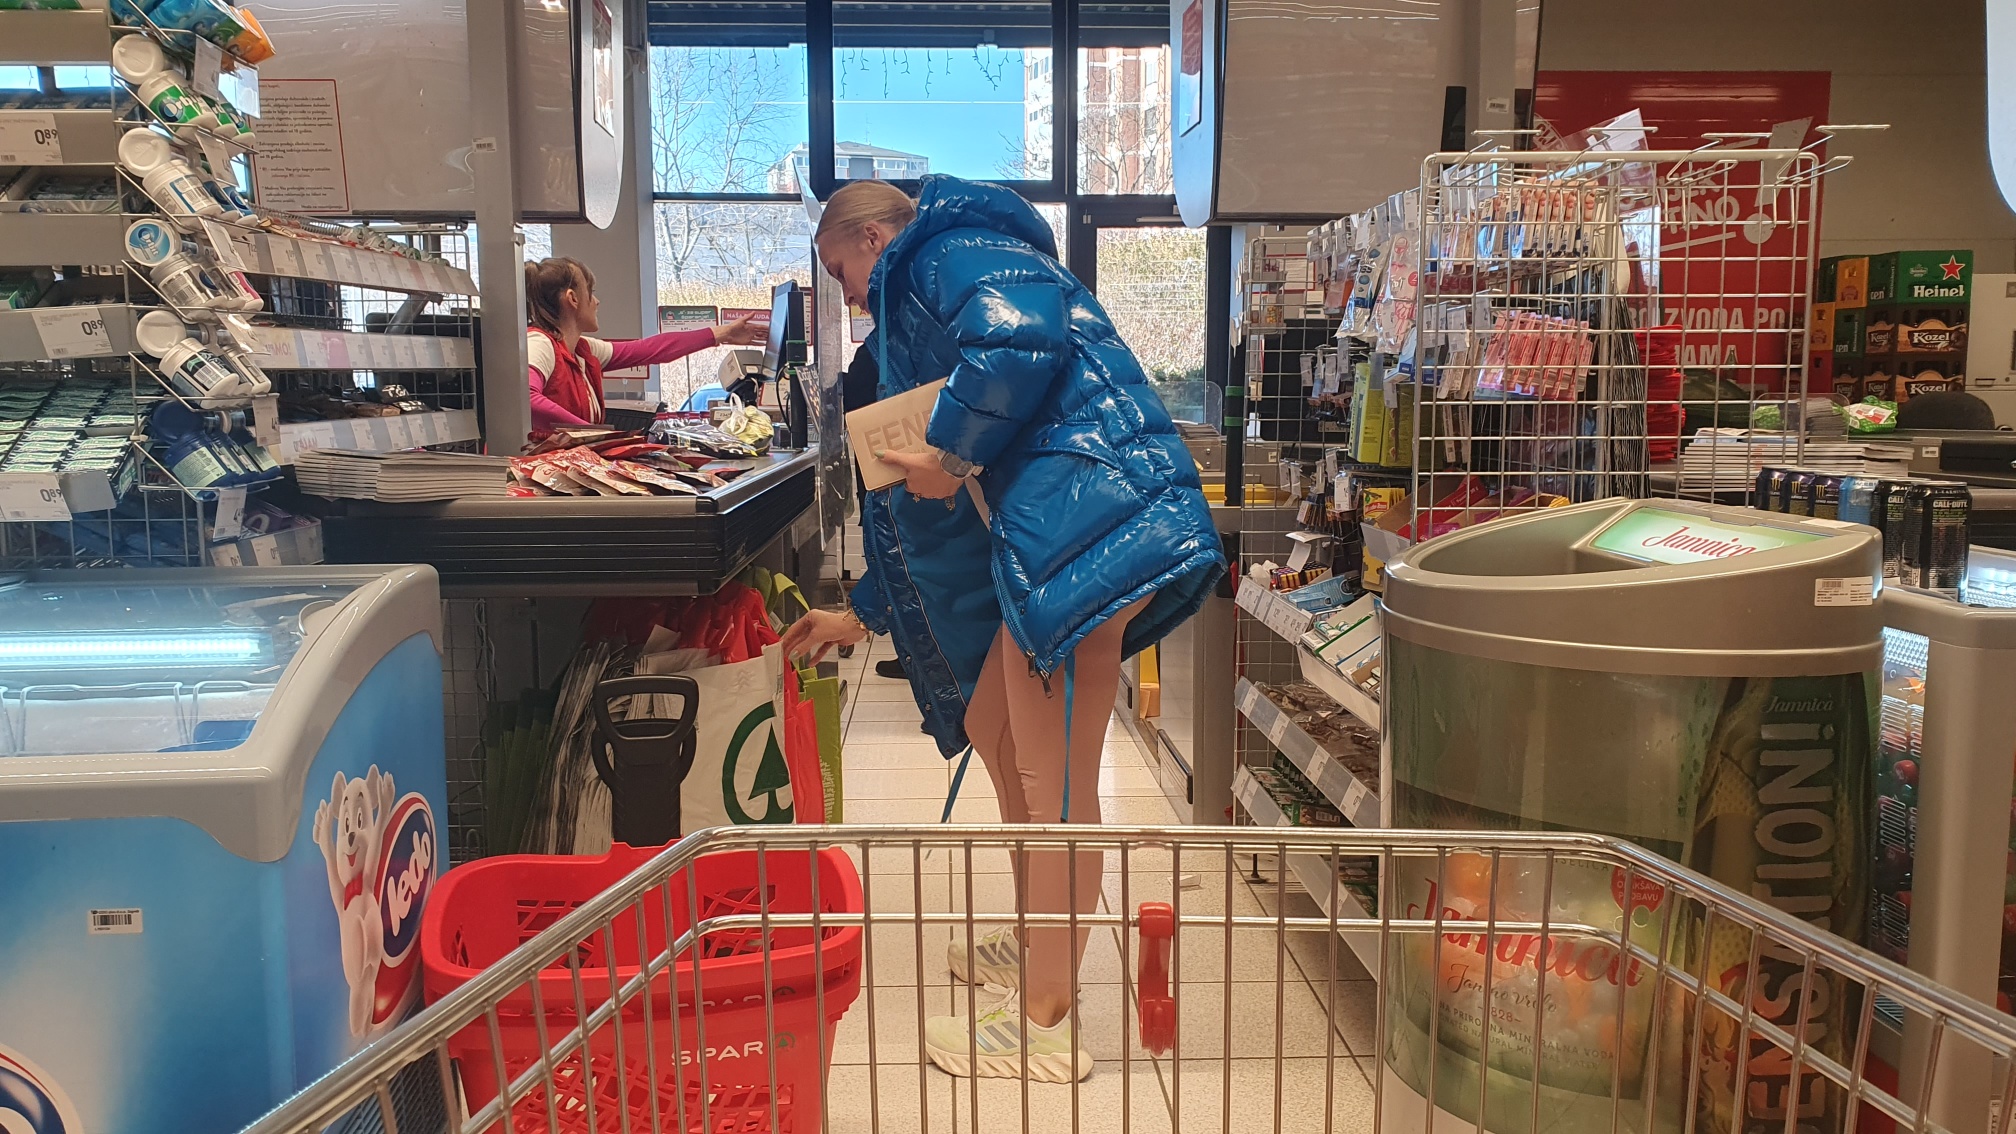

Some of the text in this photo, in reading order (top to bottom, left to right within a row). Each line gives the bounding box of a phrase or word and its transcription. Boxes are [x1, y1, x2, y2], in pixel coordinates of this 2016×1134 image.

[34, 128, 58, 146] 0,89
[82, 319, 104, 337] 0,89
[1628, 307, 1786, 330] ROIZVODA PO
[1912, 331, 1951, 351] Kozel
[1909, 383, 1947, 398] Kozel
[864, 410, 932, 461] FEN
[40, 487, 63, 505] 0,89
[1453, 1008, 1504, 1036] PRIRONA
[1509, 1030, 1579, 1056] MINRALNA
[671, 1040, 764, 1067] SPAR
